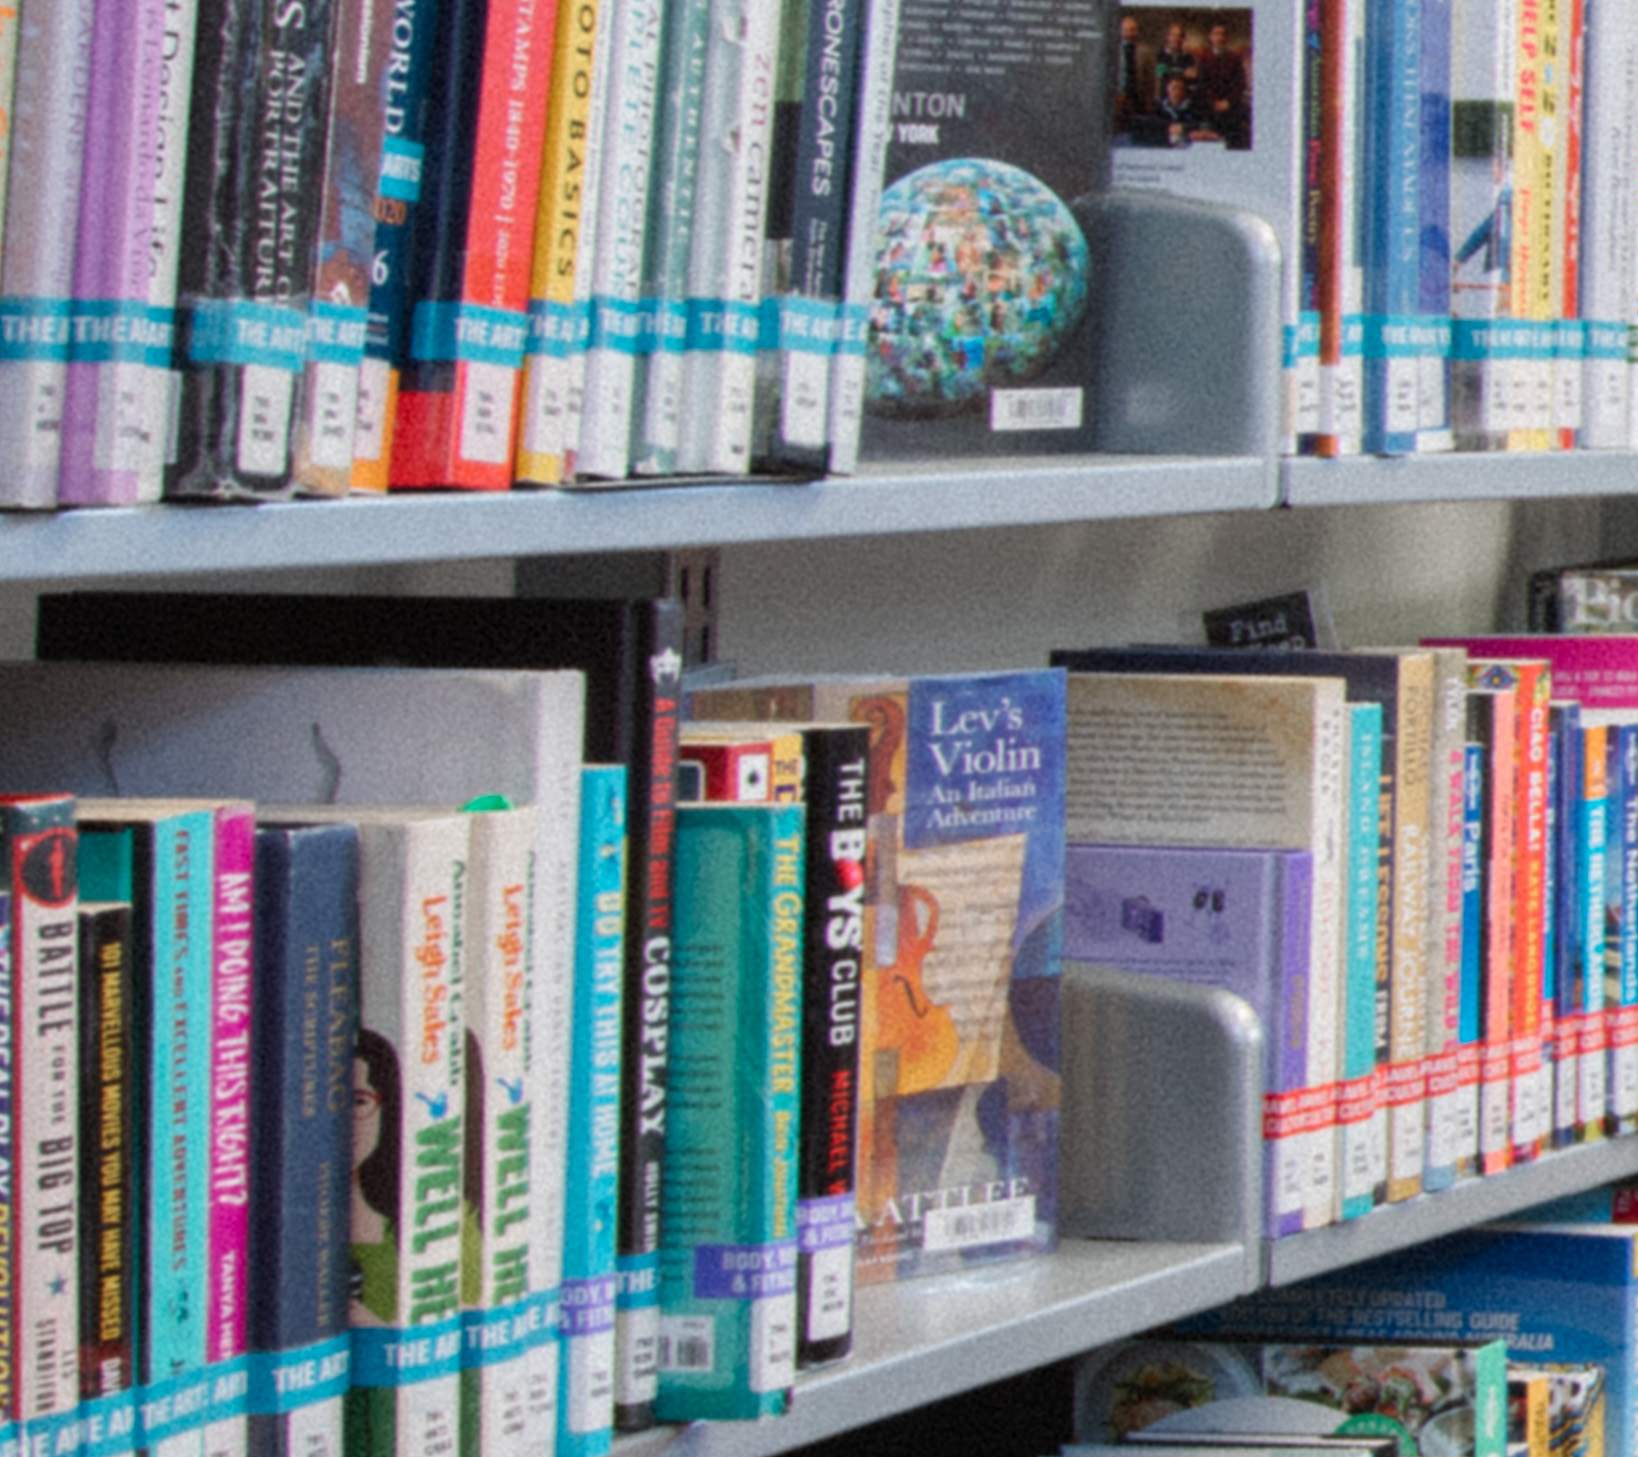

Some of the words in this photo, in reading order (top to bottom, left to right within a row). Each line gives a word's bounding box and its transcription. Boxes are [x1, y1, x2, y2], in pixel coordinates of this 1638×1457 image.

[1517, 70, 1537, 135] SELF
[497, 99, 524, 211] 1840-1970
[554, 119, 589, 280] BASICS
[928, 698, 1026, 738] Lev's
[837, 759, 865, 822] THE
[928, 742, 1044, 779] Violin
[928, 783, 959, 805] An
[966, 780, 1038, 803] Italian
[926, 802, 1039, 832] Adventure
[1623, 796, 1638, 832] The
[774, 837, 800, 886] THE
[1461, 820, 1481, 893] Paris
[36, 921, 72, 1038] BATTLE
[771, 892, 800, 1095] GRANDMASTER
[828, 959, 856, 1046] CLUB
[51, 1045, 67, 1079] FOR
[640, 936, 672, 1137] COSPLAY
[51, 1089, 66, 1125] THE
[827, 1070, 852, 1174] MICHAEL
[37, 1138, 72, 1190] BIG
[413, 1115, 456, 1254] WELL
[492, 1101, 531, 1238] WELL
[37, 1204, 72, 1256] TOP
